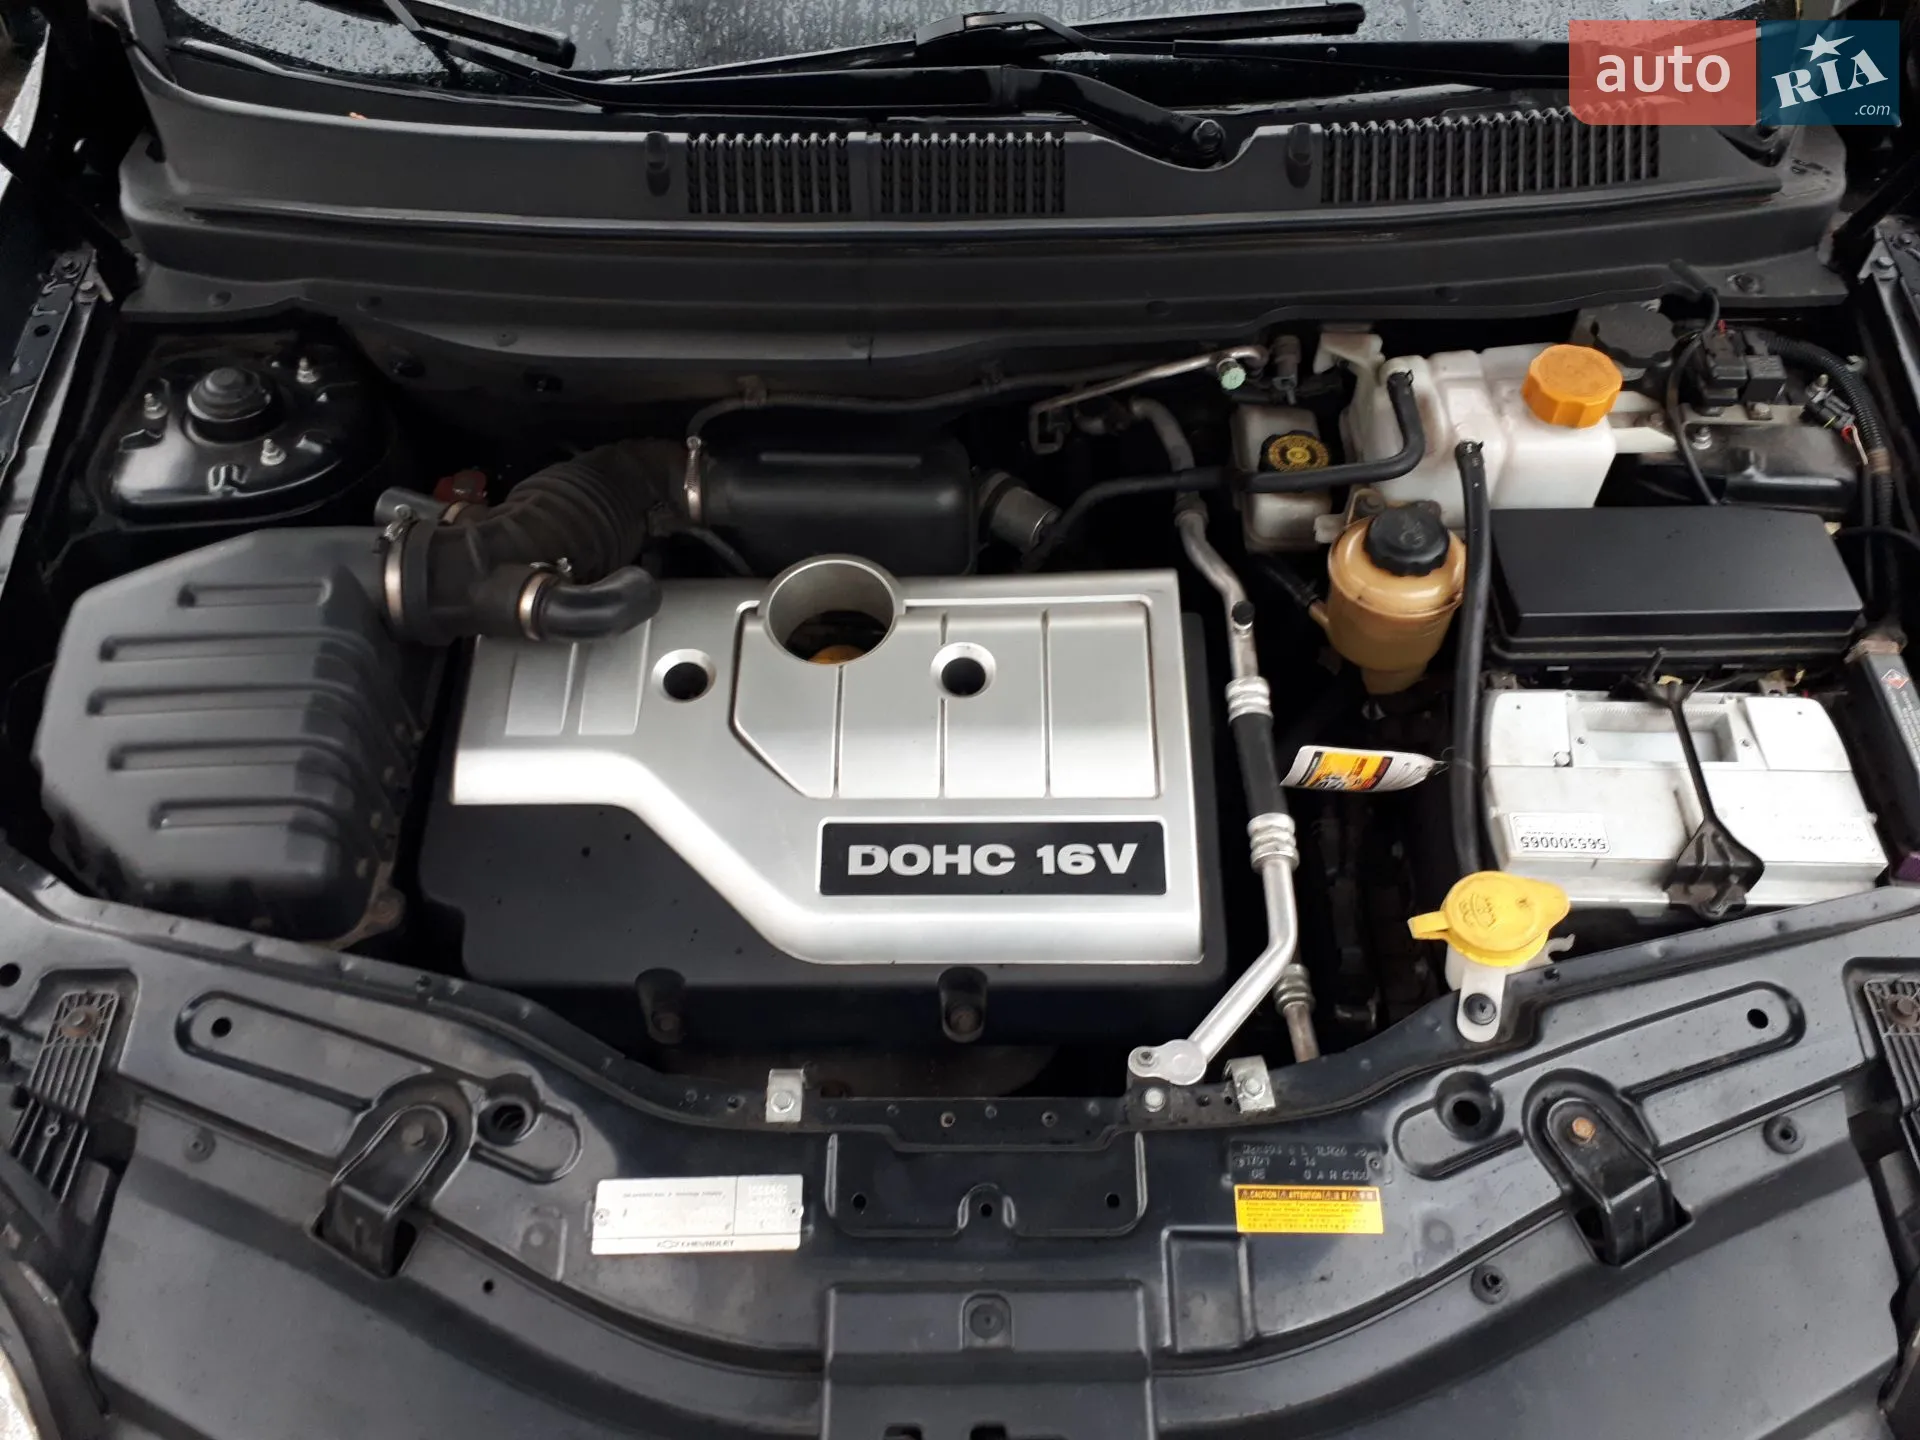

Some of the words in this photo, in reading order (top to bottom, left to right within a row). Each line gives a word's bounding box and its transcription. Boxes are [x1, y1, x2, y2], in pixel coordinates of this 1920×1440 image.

[848, 843, 1016, 876] DOHC
[1036, 843, 1139, 875] 16V
[1250, 1190, 1277, 1199] CAUTION
